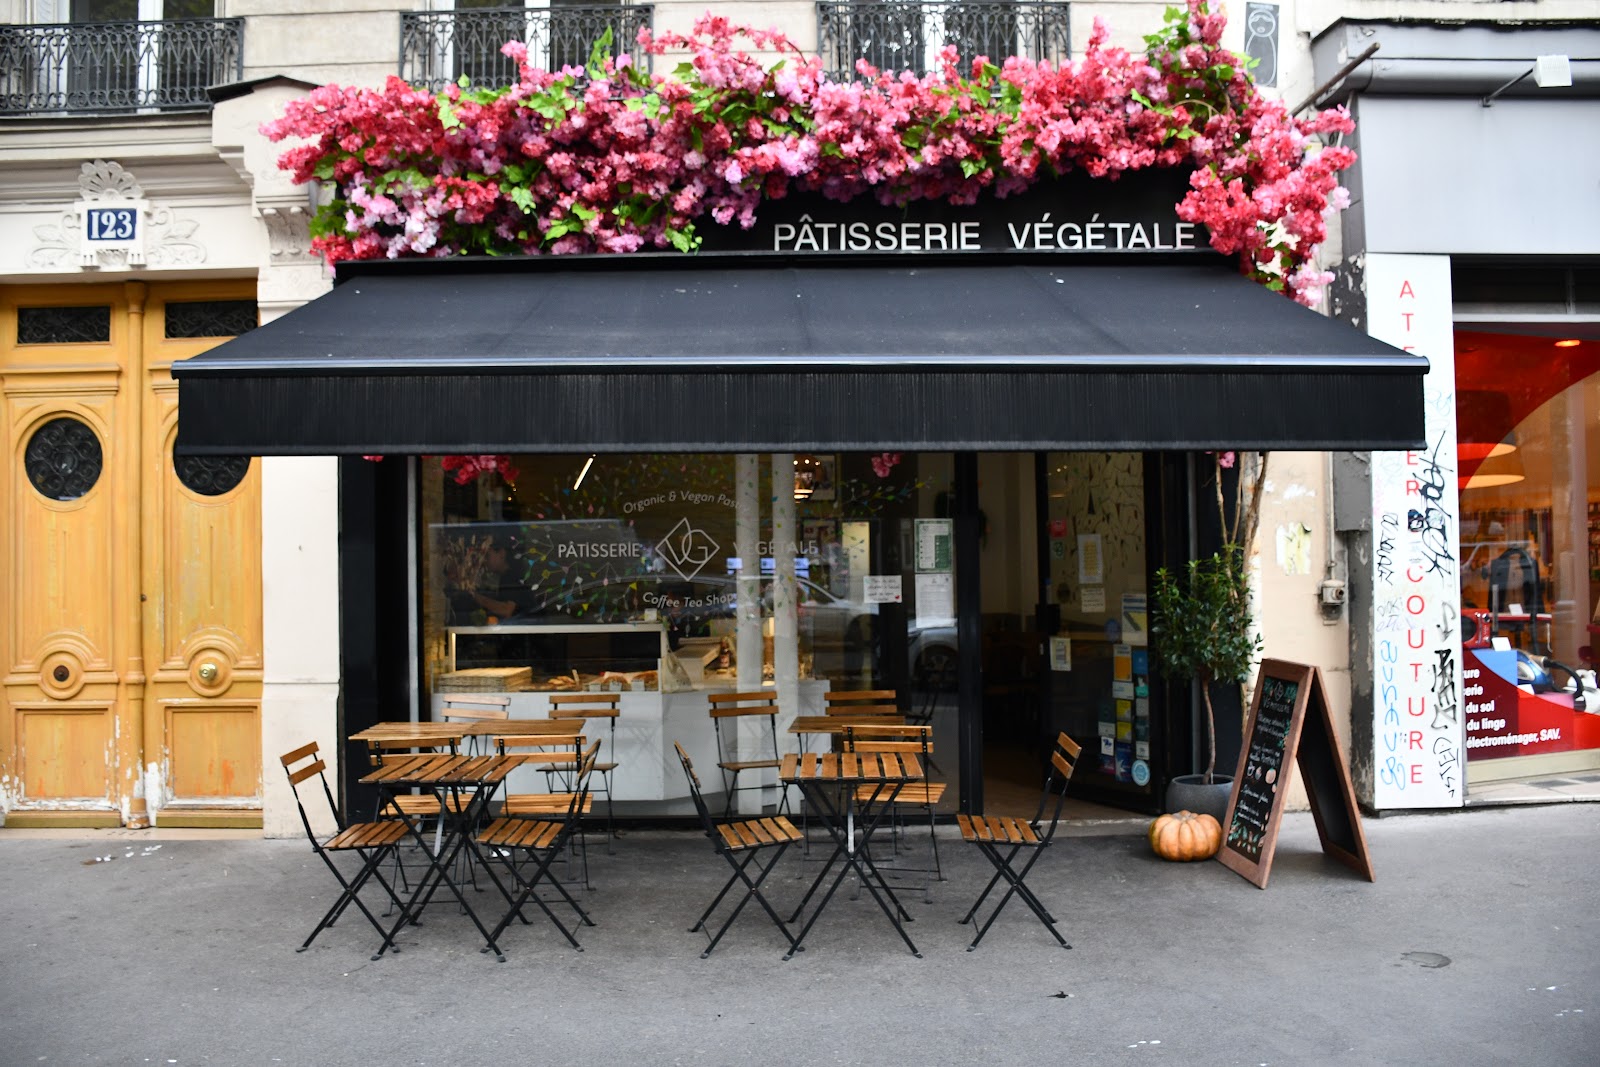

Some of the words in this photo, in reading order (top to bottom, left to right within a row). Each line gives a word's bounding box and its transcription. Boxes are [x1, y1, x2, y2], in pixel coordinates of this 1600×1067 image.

[91, 211, 133, 239] 123
[774, 214, 981, 251] PÂTISSERIE
[1007, 213, 1196, 250] VÉGÉTALE
[623, 493, 666, 514] Organic
[669, 491, 676, 502] &
[680, 490, 715, 505] Vegan
[558, 541, 641, 558] PÂTISSERIE
[642, 592, 680, 609] Coffee
[683, 597, 703, 608] Tea
[1466, 702, 1479, 714] du
[1480, 700, 1495, 713] sol
[1466, 719, 1480, 731] du
[1481, 718, 1506, 732] linge
[1466, 733, 1539, 749] électroménager,
[1540, 728, 1561, 742] SAV.
